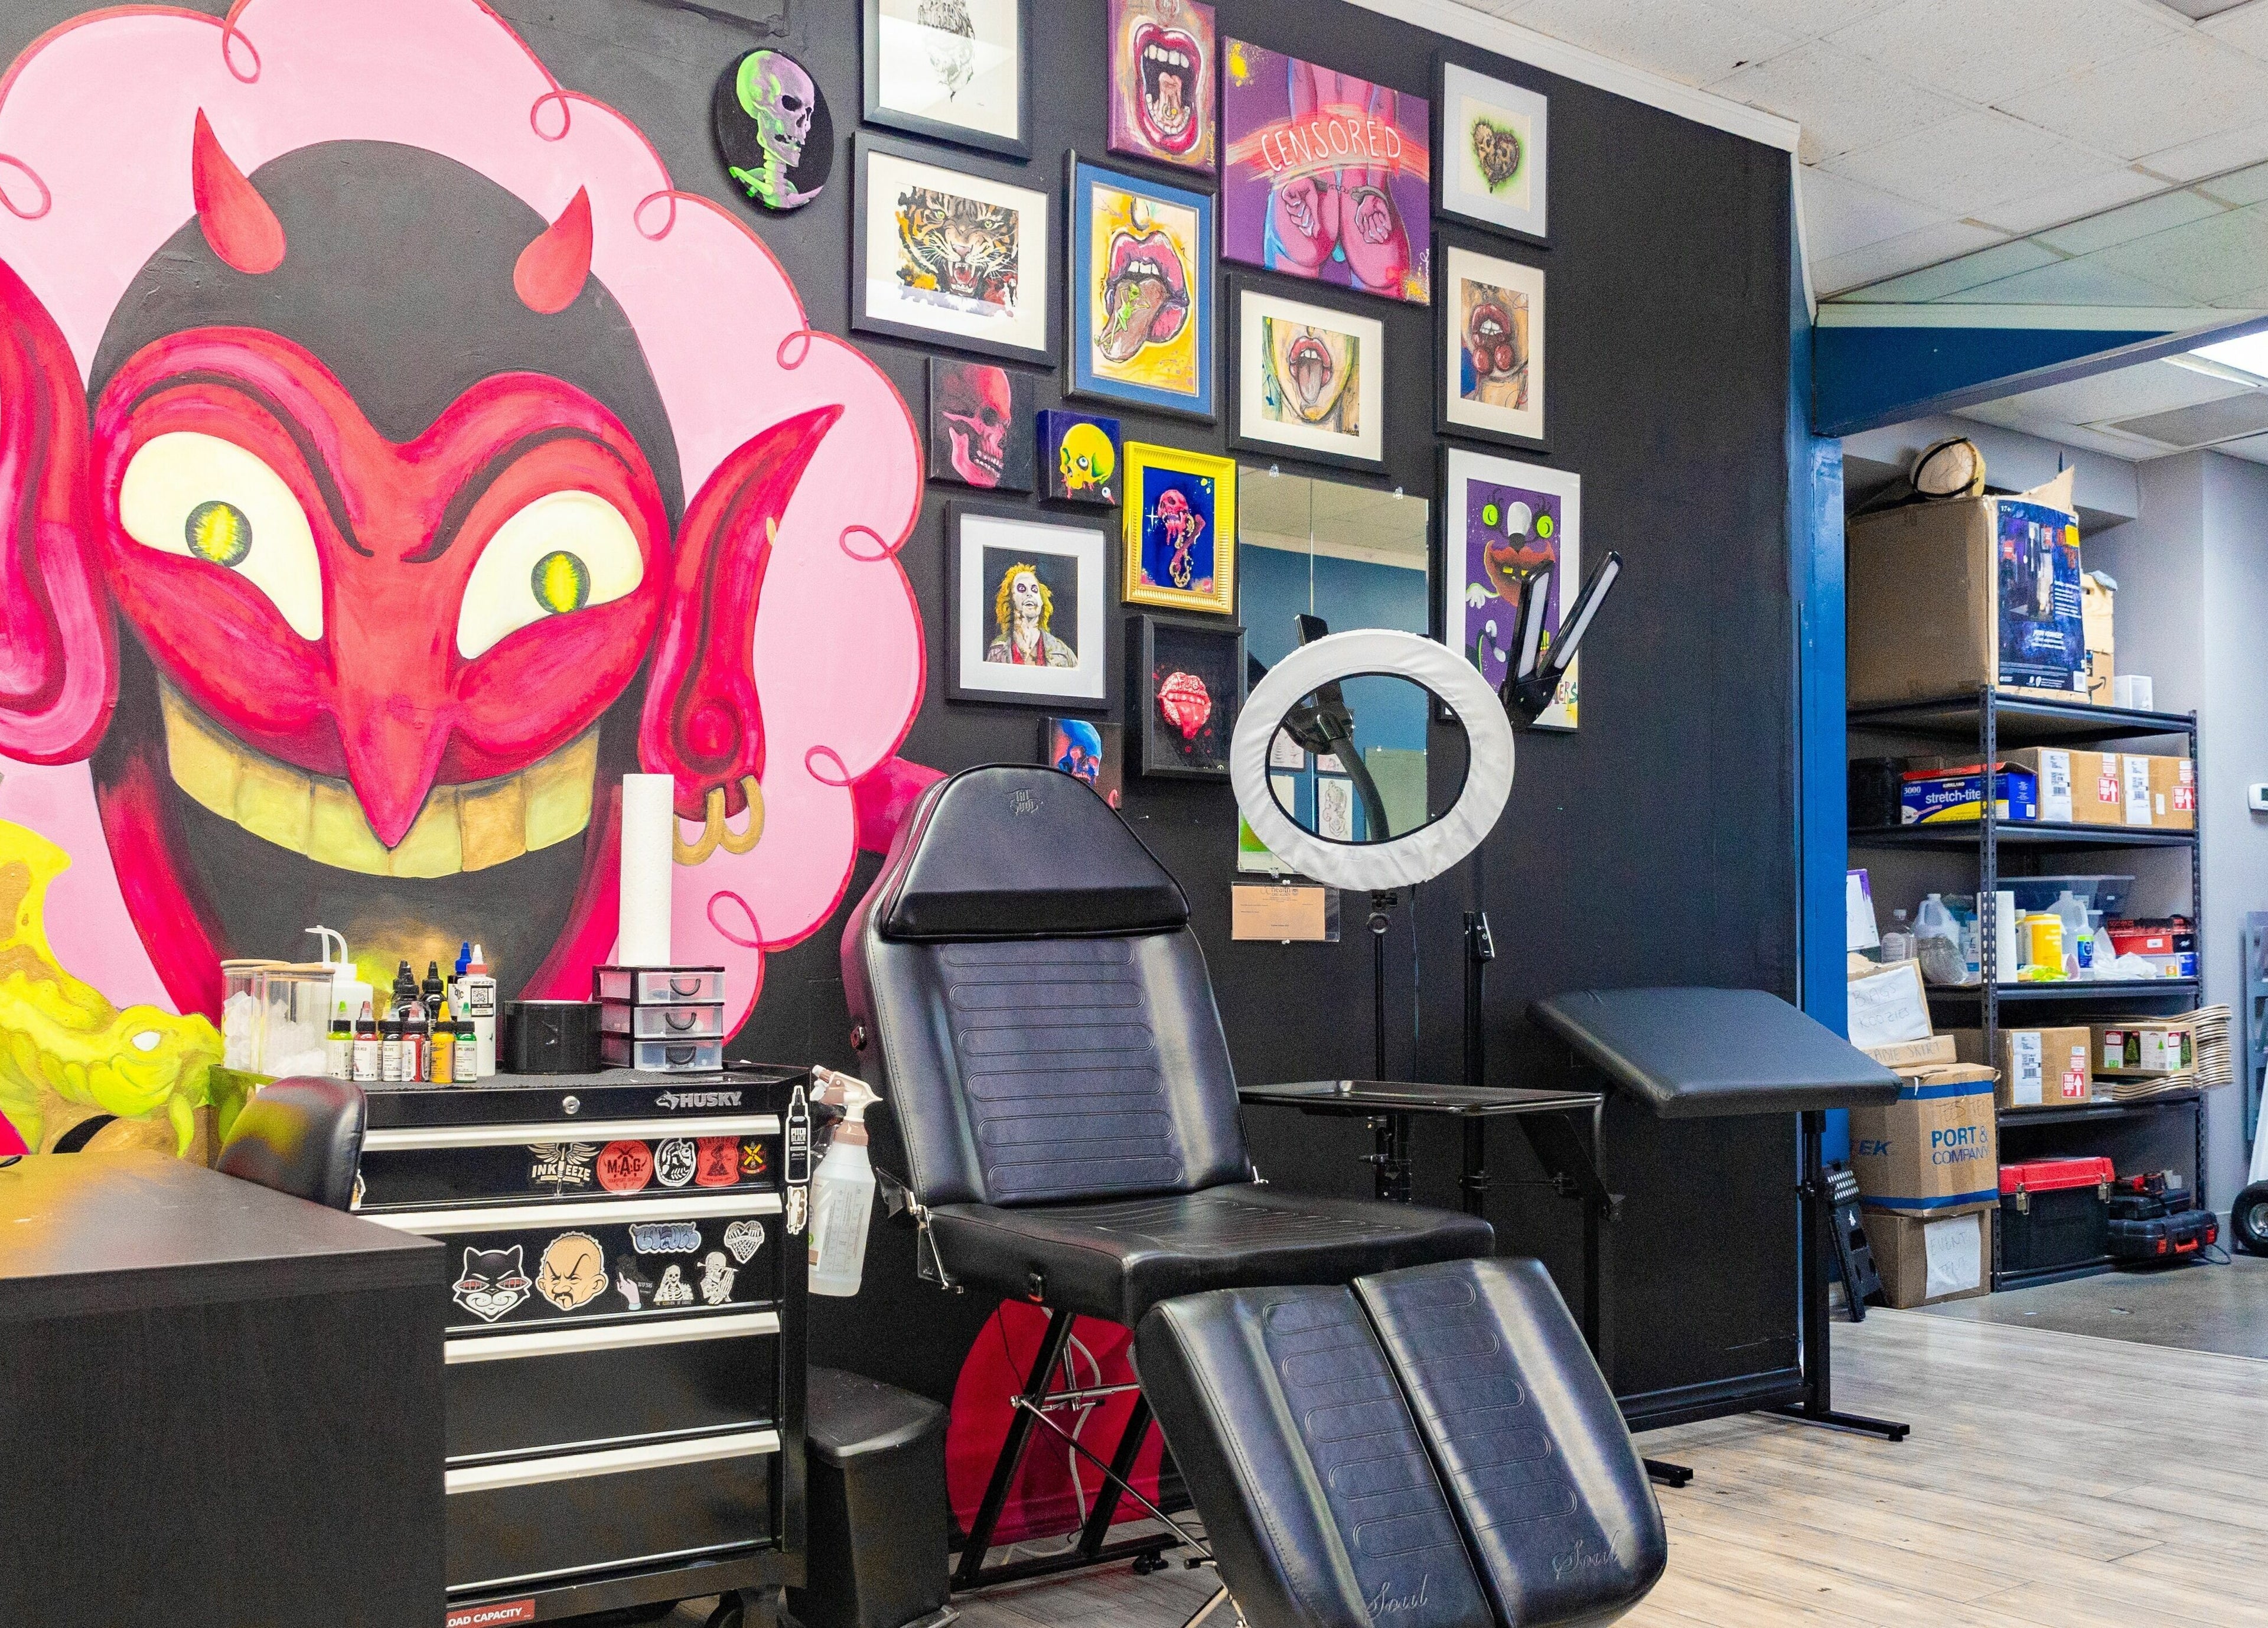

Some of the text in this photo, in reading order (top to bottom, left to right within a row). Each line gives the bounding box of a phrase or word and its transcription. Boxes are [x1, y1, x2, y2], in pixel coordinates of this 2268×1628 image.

[1261, 119, 1400, 172] CENSORED
[1904, 786, 1921, 795] 3000
[1925, 789, 1981, 804] stretch-tite
[1852, 985, 1896, 1007] BAGS
[1907, 1041, 1940, 1058] SKIRT
[680, 1092, 742, 1108] HUSKY
[1931, 1125, 1988, 1148] PORT &
[1931, 1145, 1990, 1165] COMPANY
[532, 1164, 591, 1181] INK EEZE
[447, 1607, 523, 1628] OAD CAPACITY
